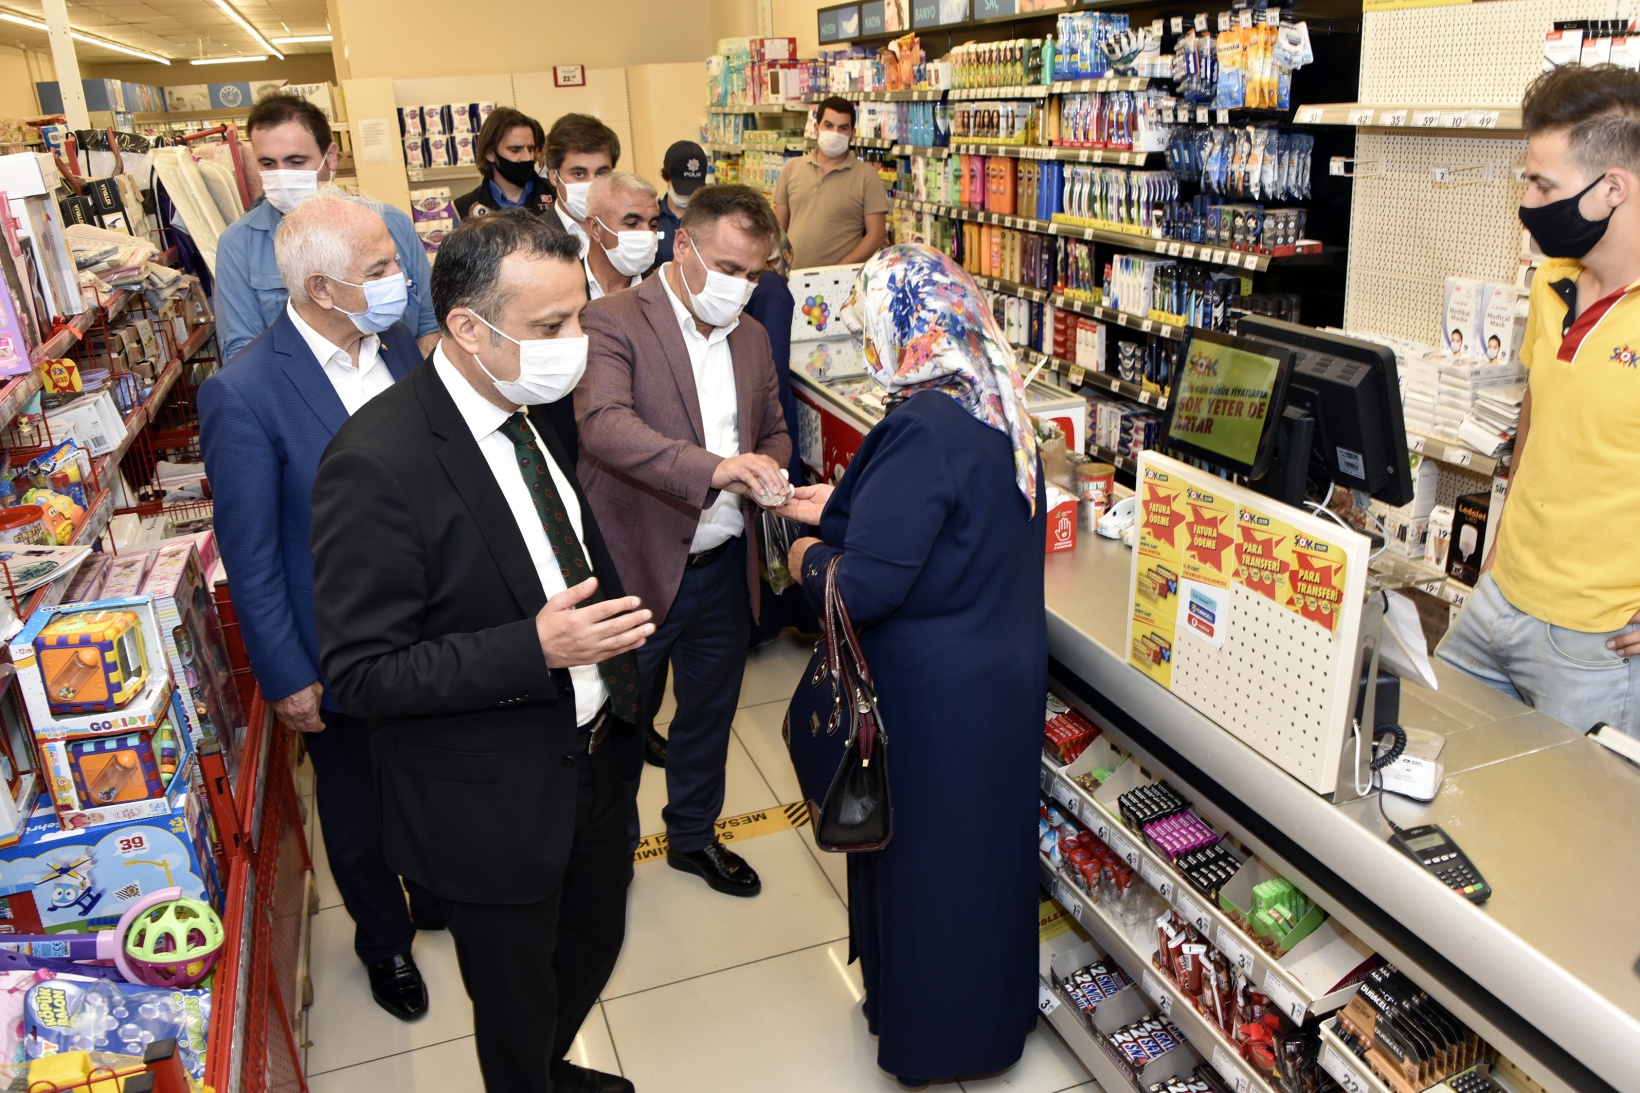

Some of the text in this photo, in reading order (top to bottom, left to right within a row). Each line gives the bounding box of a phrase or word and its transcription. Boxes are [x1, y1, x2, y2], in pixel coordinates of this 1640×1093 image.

[864, 15, 881, 29] KADIN
[914, 6, 936, 22] BANYO
[1422, 116, 1434, 127] 59
[100, 183, 112, 206] VIVALDI
[1195, 384, 1208, 395] GÜN
[1177, 395, 1267, 420] ŞOK YETER DE
[1173, 414, 1214, 435] ARTAR
[1144, 467, 1159, 481] ŞOK
[1186, 487, 1203, 502] ŞOK
[1149, 502, 1171, 516] FATURA
[1238, 508, 1257, 525] ŞOK
[1149, 512, 1171, 527] ÖDEME
[1193, 524, 1219, 539] FATURA
[1193, 534, 1217, 551] ÖDEME
[1242, 541, 1264, 556] PARA
[1294, 533, 1314, 551] ŞOK
[1241, 554, 1281, 573] TRANSFERİ
[1298, 569, 1320, 584] PARA
[1296, 581, 1339, 602] TRANSFERİ
[89, 714, 149, 732] GOKIDY
[119, 835, 145, 851] 39
[1371, 971, 1383, 983] AAA
[37, 986, 58, 1028] KÖPÜK
[1040, 999, 1051, 1010] 3
[1374, 1026, 1404, 1059] DURACELL
